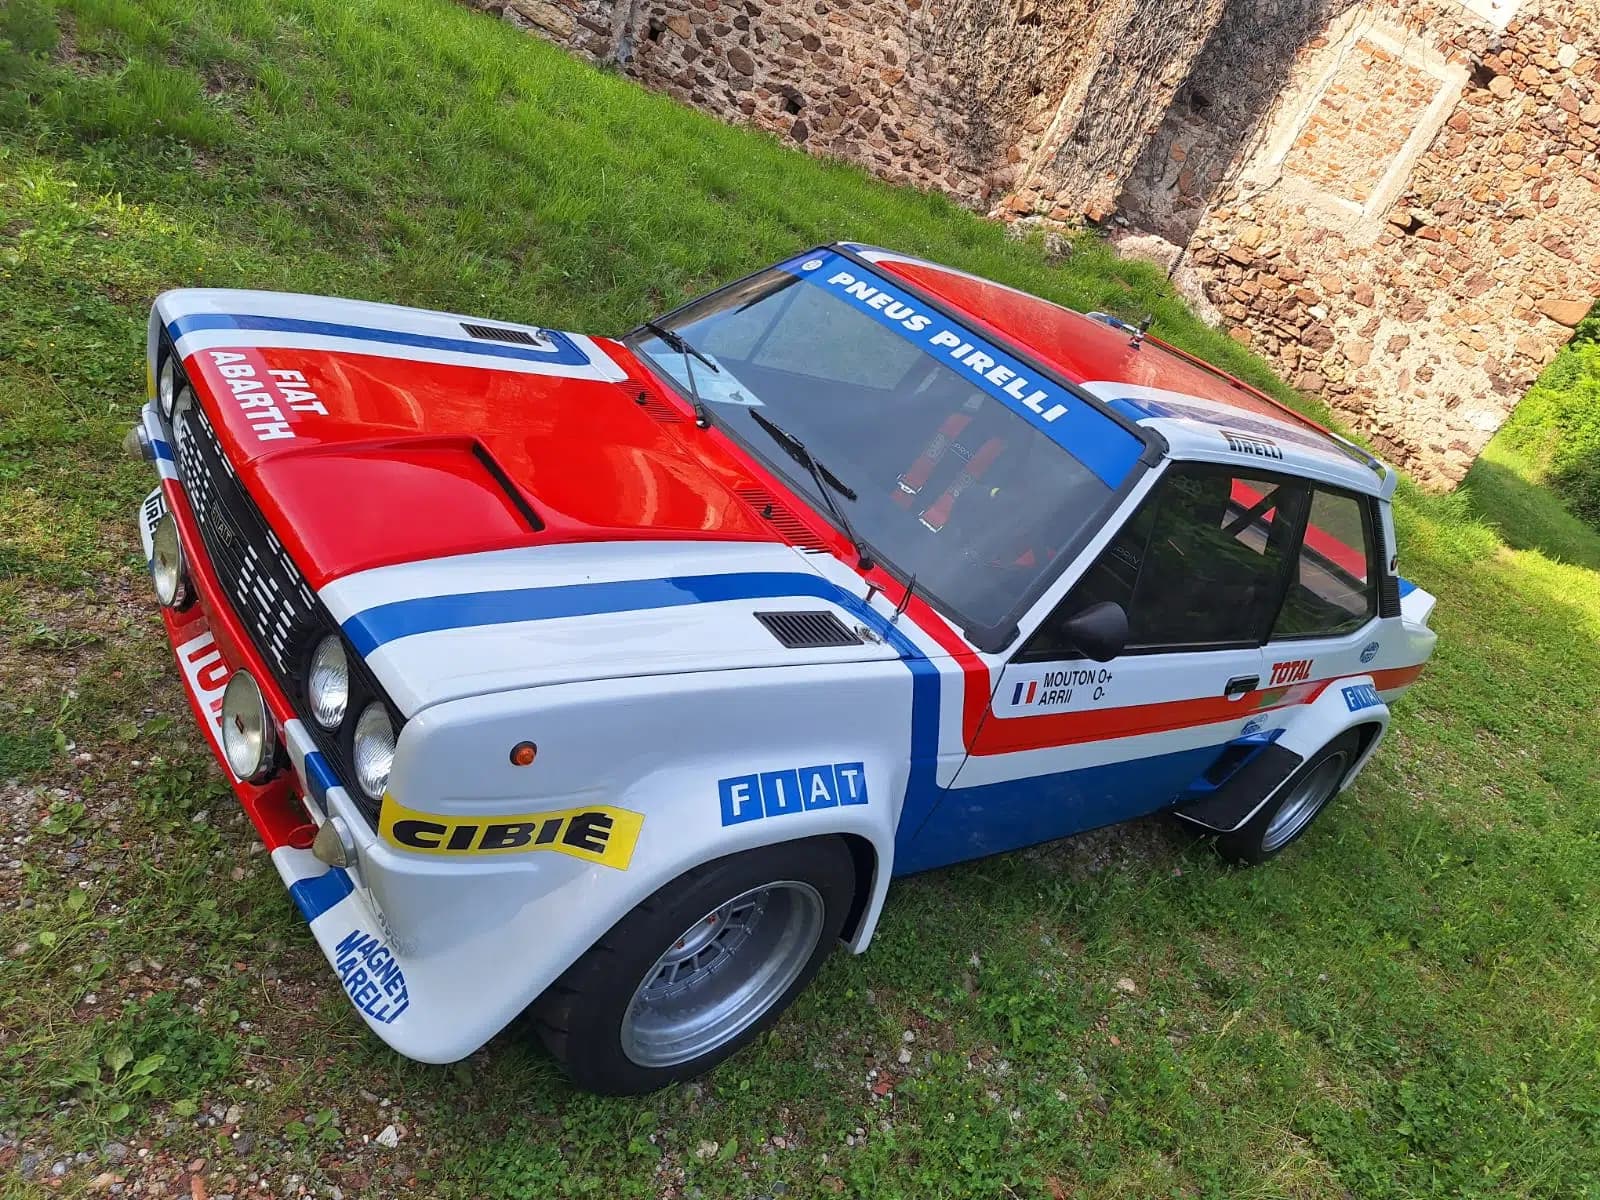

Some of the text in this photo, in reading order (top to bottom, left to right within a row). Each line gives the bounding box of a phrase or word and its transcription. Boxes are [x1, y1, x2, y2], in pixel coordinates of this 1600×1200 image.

[827, 271, 1069, 422] PNEUS PIRELLI
[209, 351, 296, 441] ABARTH
[267, 369, 329, 415] FIAT
[1219, 429, 1283, 460] PIRELLI
[1043, 670, 1096, 688] MOUTON
[1269, 659, 1314, 686] TOTAL
[1038, 689, 1073, 706] ARRII
[731, 769, 858, 817] FIAT
